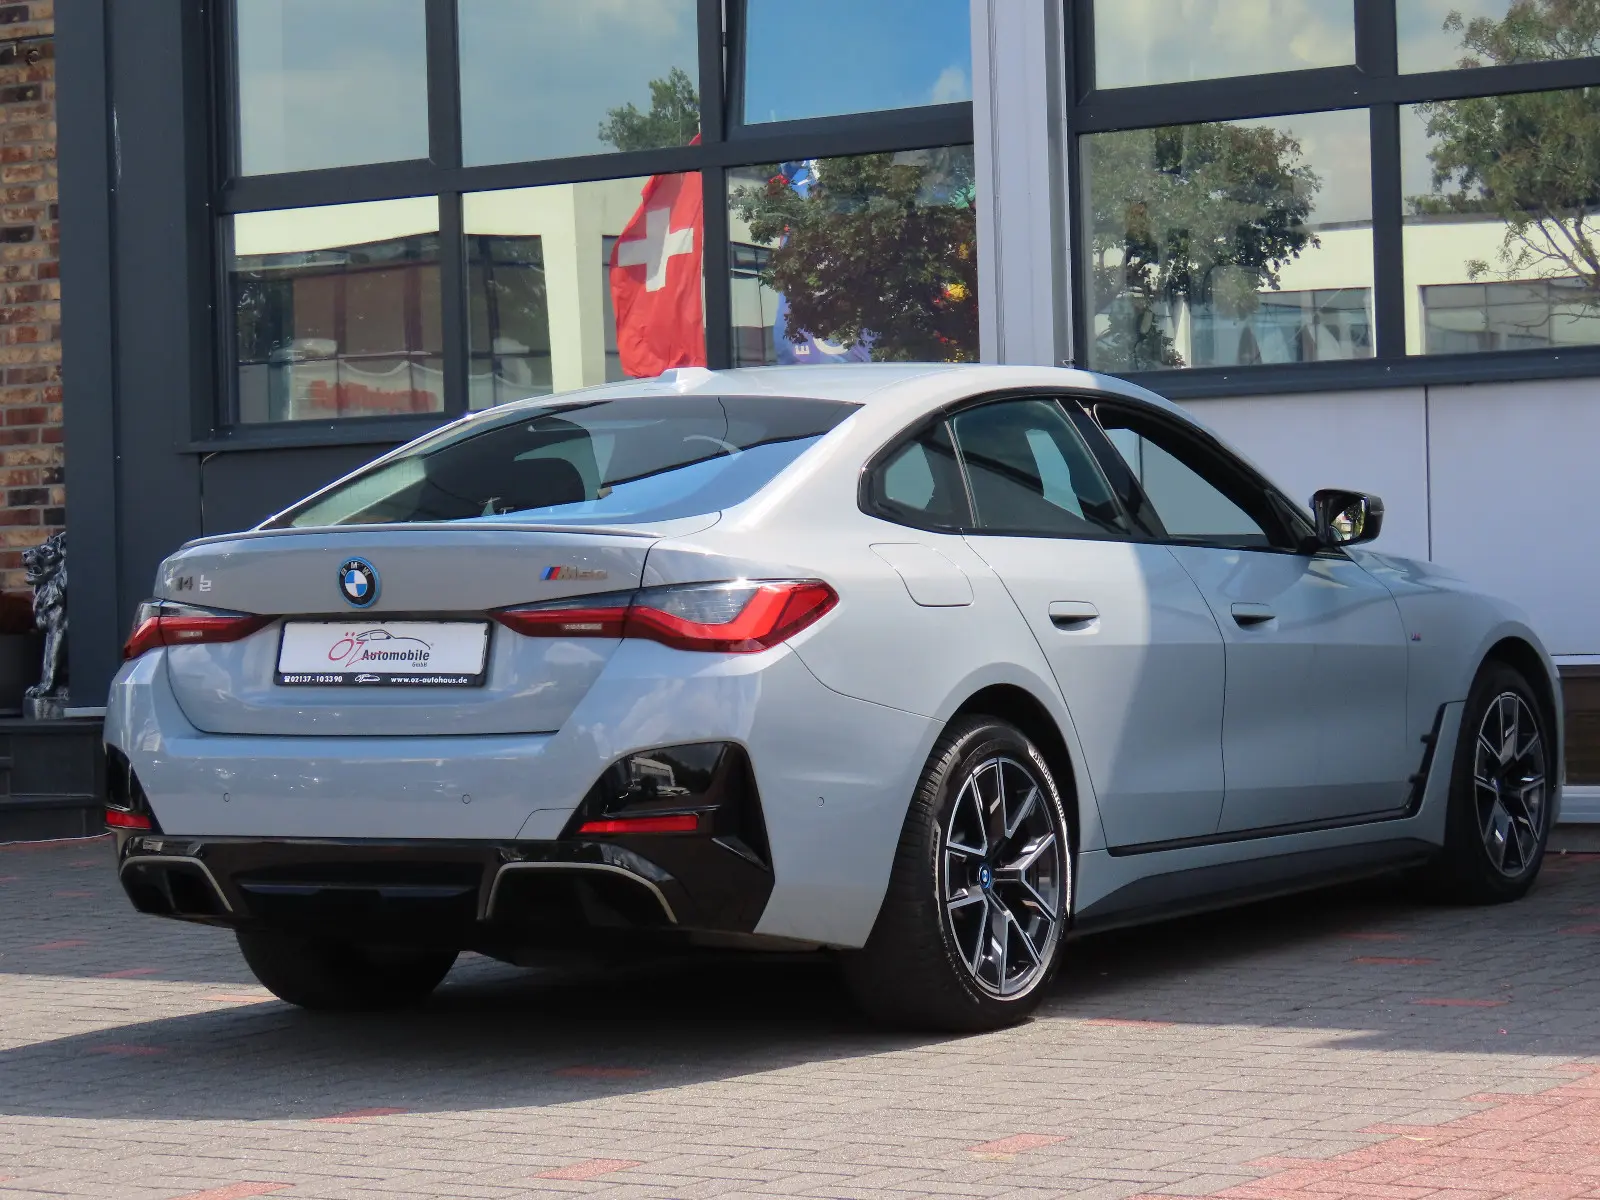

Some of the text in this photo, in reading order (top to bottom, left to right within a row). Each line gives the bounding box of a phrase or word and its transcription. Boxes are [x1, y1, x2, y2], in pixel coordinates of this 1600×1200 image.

[340, 561, 371, 577] BMW
[361, 649, 430, 661] Automobile
[390, 676, 468, 684] www.oz-autohaus.de
